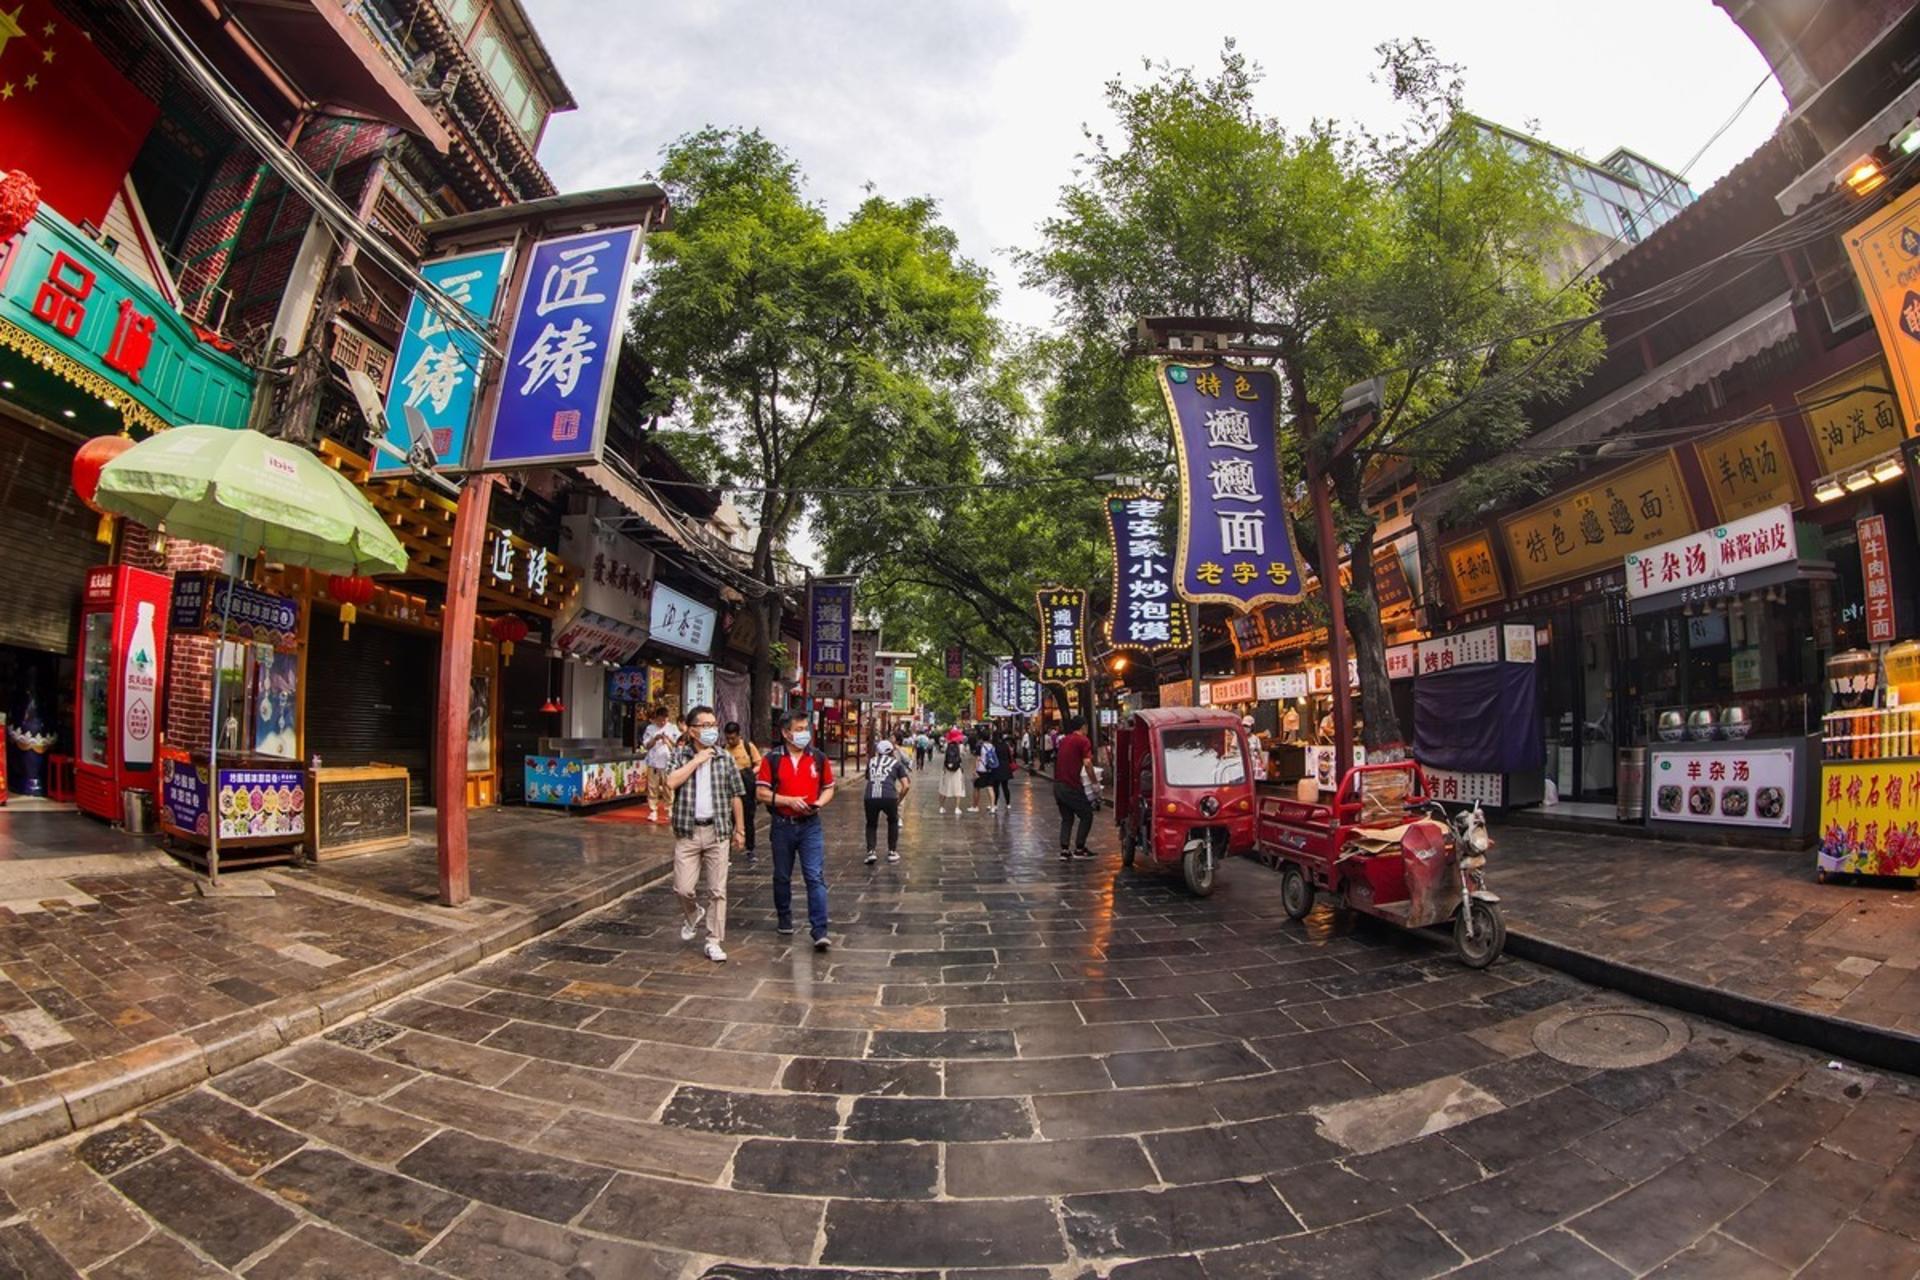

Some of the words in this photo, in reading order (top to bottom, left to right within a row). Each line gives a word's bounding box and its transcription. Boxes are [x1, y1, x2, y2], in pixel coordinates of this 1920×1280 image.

[518, 241, 611, 397] 匠铸
[1195, 372, 1258, 400] 特色
[269, 457, 295, 473] ibis
[1718, 440, 1777, 495] 羊肉汤
[1720, 522, 1786, 566] 麻酱凉皮
[1126, 499, 1170, 641] 老安家小炒泡馍
[1195, 561, 1292, 585] 老字号
[1638, 543, 1707, 589] 羊杂汤
[1425, 648, 1454, 672] 烤肉
[1686, 760, 1749, 781] 羊杂汤
